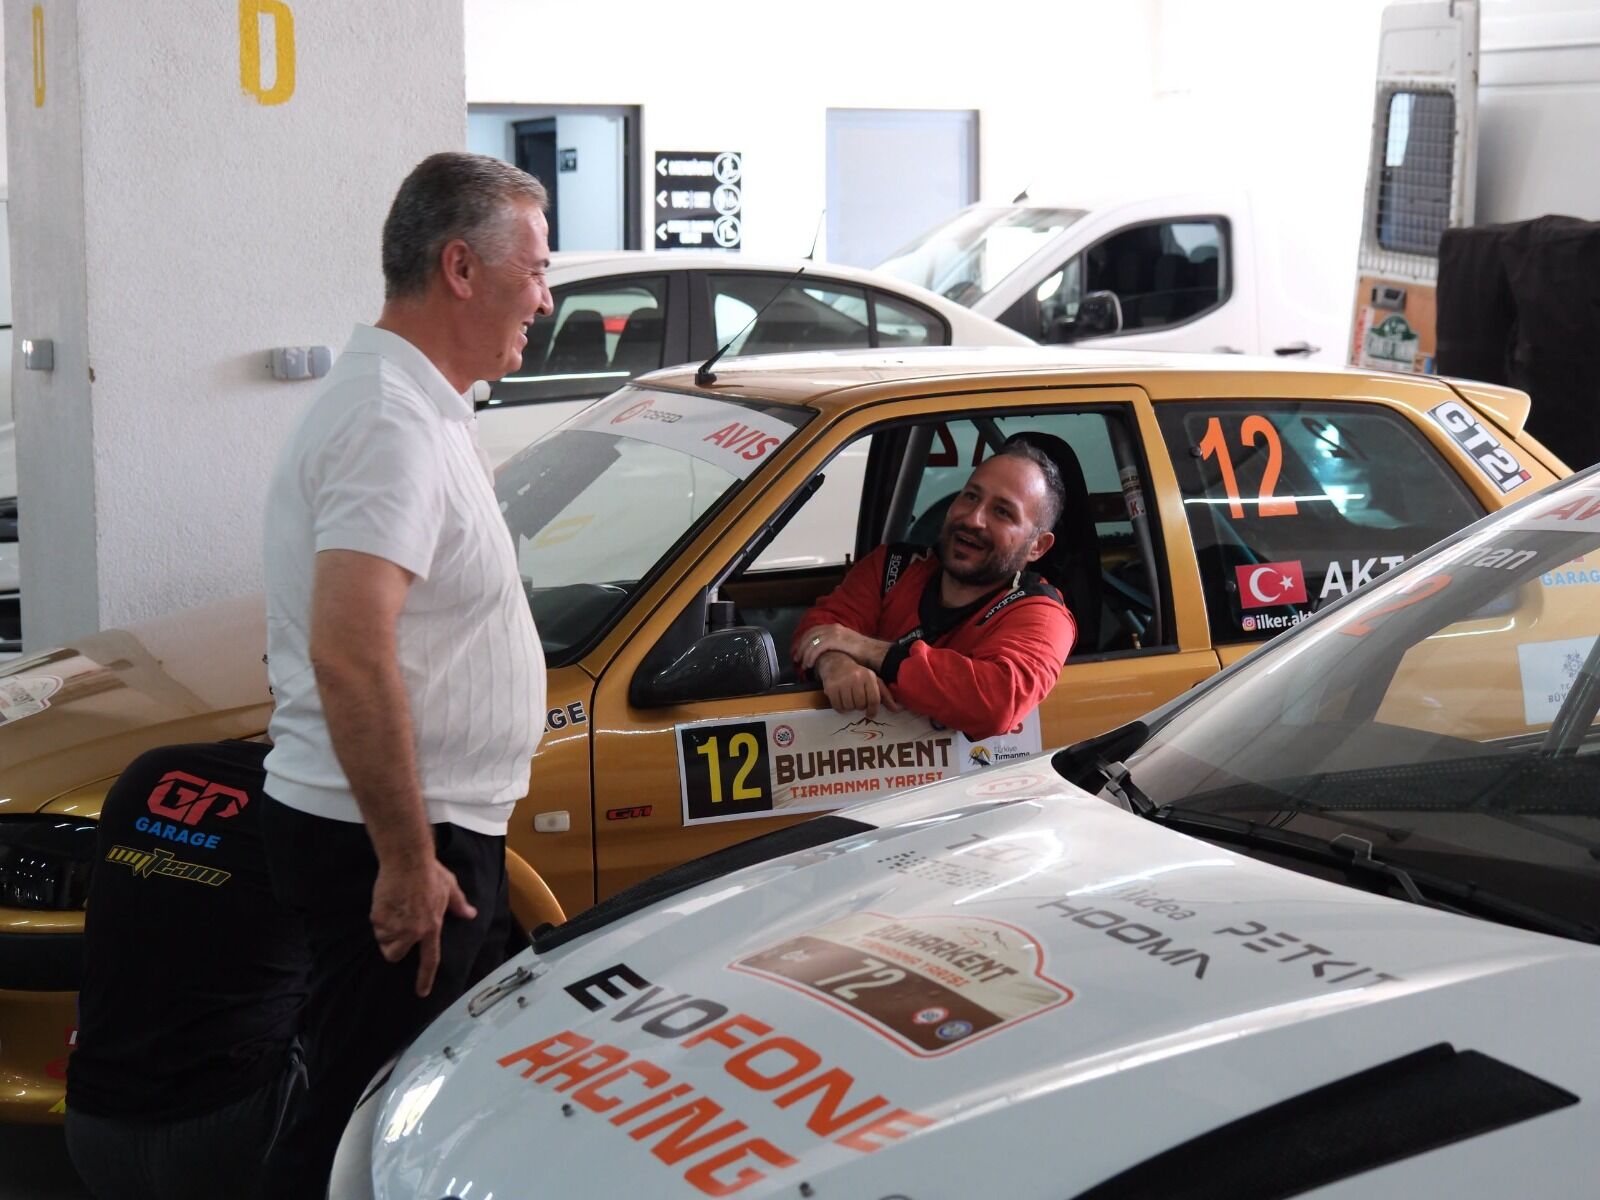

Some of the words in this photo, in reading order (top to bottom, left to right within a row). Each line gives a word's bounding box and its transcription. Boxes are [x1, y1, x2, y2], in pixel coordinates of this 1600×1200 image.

[240, 0, 296, 106] D
[703, 422, 781, 461] AVIS
[1199, 414, 1299, 519] 12
[1434, 401, 1532, 494] GT2i
[544, 701, 588, 733] GE
[697, 732, 763, 803] 12
[775, 738, 952, 785] BUHARKENT
[790, 778, 880, 799] TIRMANMA
[135, 816, 222, 849] GARAGE
[811, 957, 909, 1001] 72
[865, 922, 1020, 983] BUHARKENT
[495, 1030, 800, 1198] RACING
